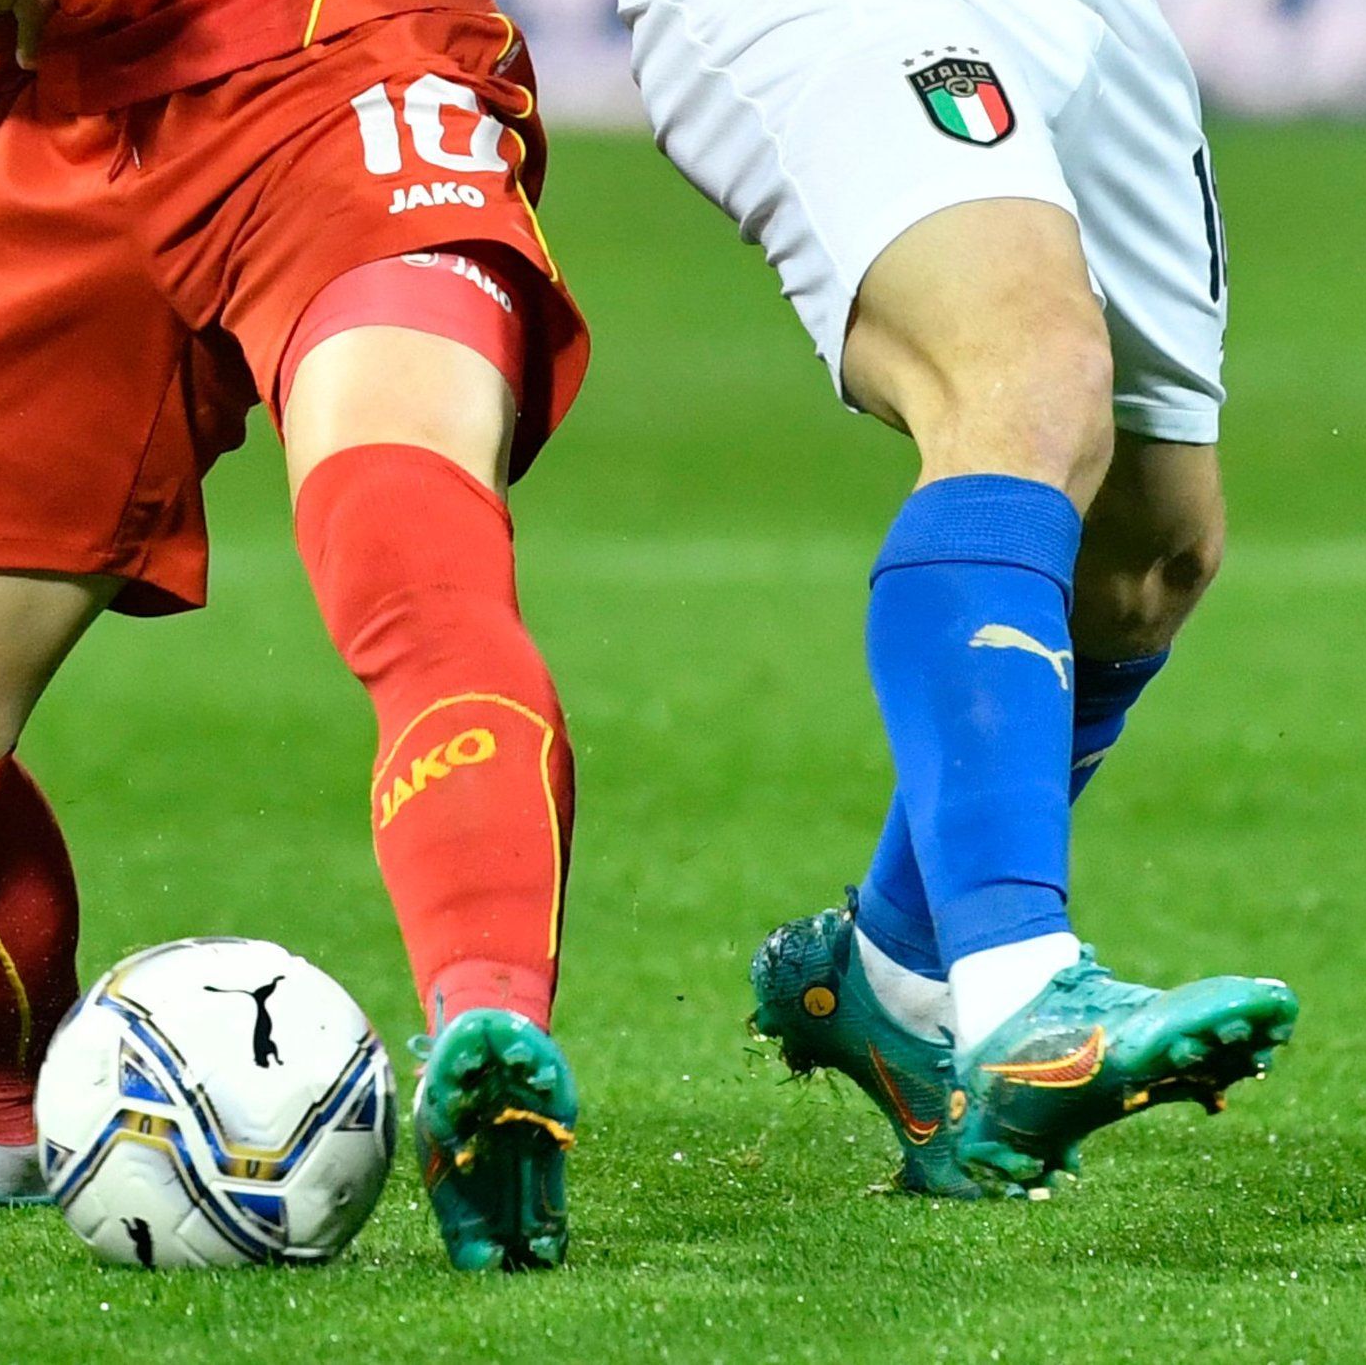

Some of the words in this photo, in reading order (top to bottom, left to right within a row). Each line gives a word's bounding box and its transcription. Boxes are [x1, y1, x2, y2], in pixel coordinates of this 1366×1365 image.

[915, 62, 990, 88] ITALIA
[350, 72, 509, 175] 10
[388, 181, 485, 215] JAKO
[451, 255, 514, 314] JAKO
[379, 728, 497, 831] JAKO
